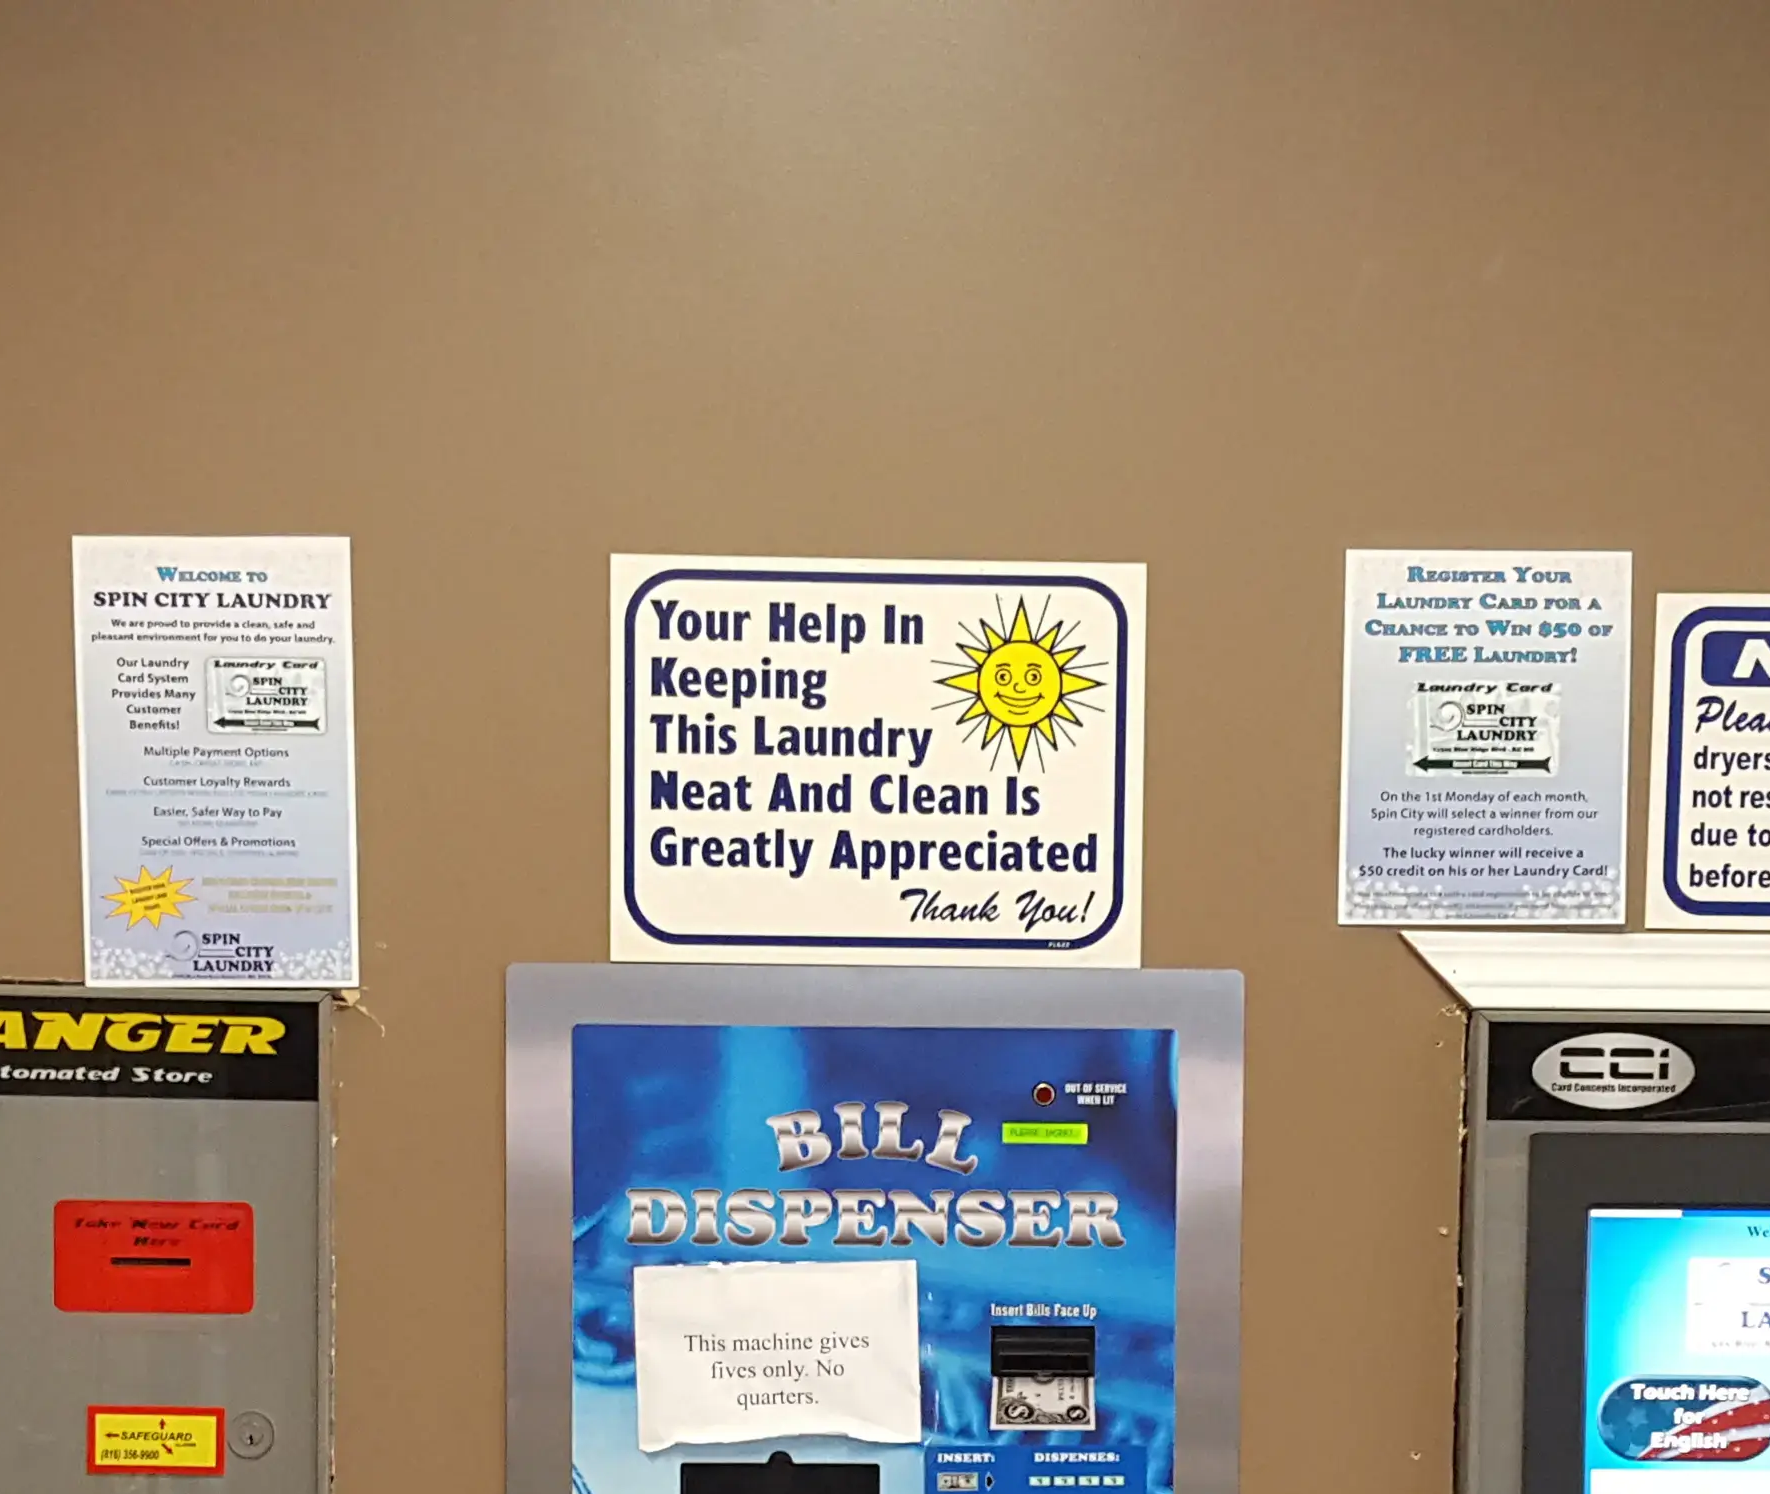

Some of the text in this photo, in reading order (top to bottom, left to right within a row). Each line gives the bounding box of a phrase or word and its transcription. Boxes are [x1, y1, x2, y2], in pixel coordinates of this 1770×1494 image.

[93, 592, 331, 609] SPIN CITY LAUNDRY
[650, 599, 924, 653] Your Help In
[1538, 620, 1581, 638] $50
[1398, 646, 1468, 663] FREE
[650, 656, 827, 709] Keeping
[650, 713, 932, 767] This Laundry
[144, 746, 289, 760] Multiple Payment Options
[650, 770, 1041, 816] Neat And Clean Is
[1380, 791, 1398, 802] On
[1402, 792, 1421, 802] the
[1426, 792, 1442, 802] 1st
[1445, 792, 1494, 804] Monday
[1497, 791, 1510, 802] of
[1513, 792, 1541, 802] each
[1692, 786, 1733, 808] not
[1691, 823, 1737, 848] due
[650, 826, 1097, 881] Greatly Appreciated
[899, 887, 1095, 932] Thank You!
[132, 1067, 215, 1084] Store
[1065, 1083, 1127, 1094] OUT OF SERVICE
[1551, 1083, 1676, 1093] Card Concepts Incorporated
[1077, 1095, 1115, 1105] WHEN LIT
[765, 1100, 979, 1175] BILL
[625, 1188, 1126, 1249] DISPENSER
[991, 1304, 1097, 1319] Insert Bills Face Up
[683, 1331, 870, 1354] This machine gives
[711, 1359, 845, 1382] fives only. No
[736, 1390, 819, 1410] quarters.
[1630, 1384, 1750, 1401] Touch Here
[1673, 1408, 1706, 1425] for
[121, 1431, 192, 1442] SAFEGUARD
[1650, 1432, 1728, 1452] English
[937, 1452, 1119, 1463] INSERT: DISPENSES:
